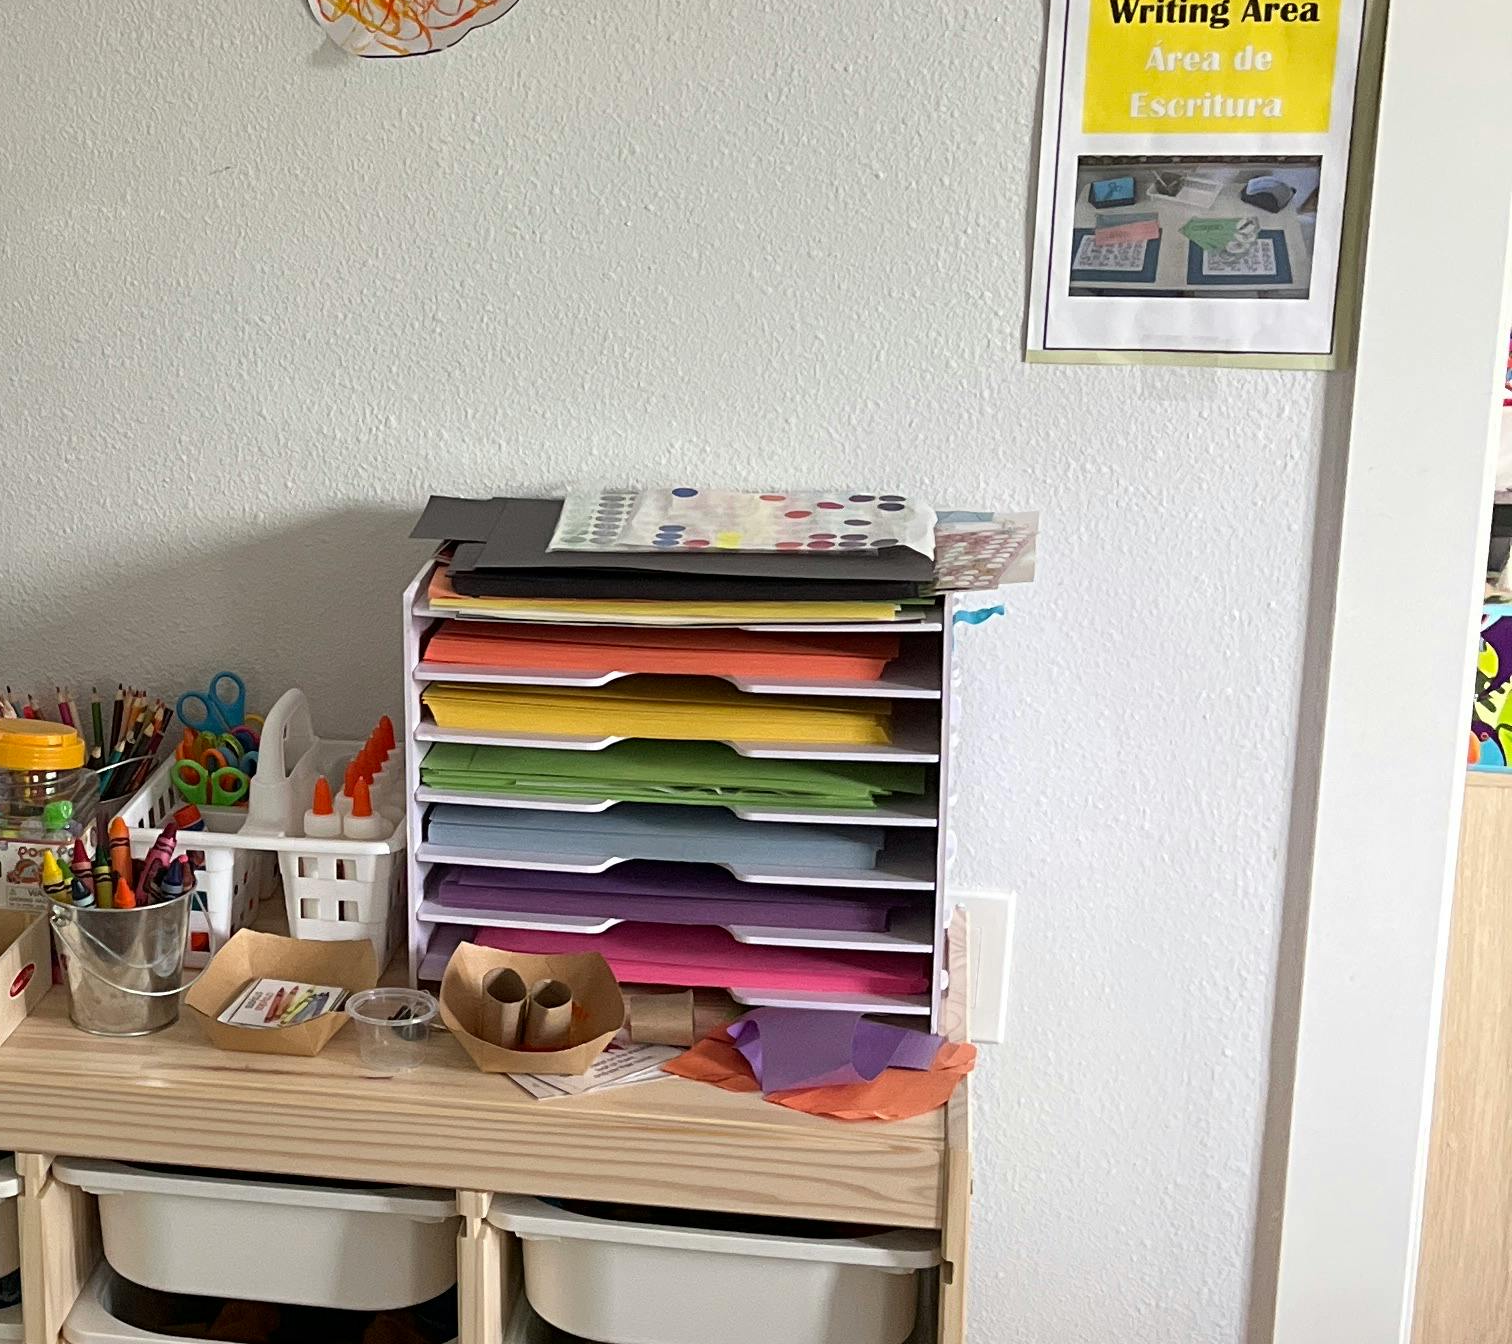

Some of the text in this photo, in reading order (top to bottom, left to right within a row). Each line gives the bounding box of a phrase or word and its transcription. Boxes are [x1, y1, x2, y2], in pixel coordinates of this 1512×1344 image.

[1144, 40, 1273, 72] Área de
[1129, 91, 1283, 119] Escritura
